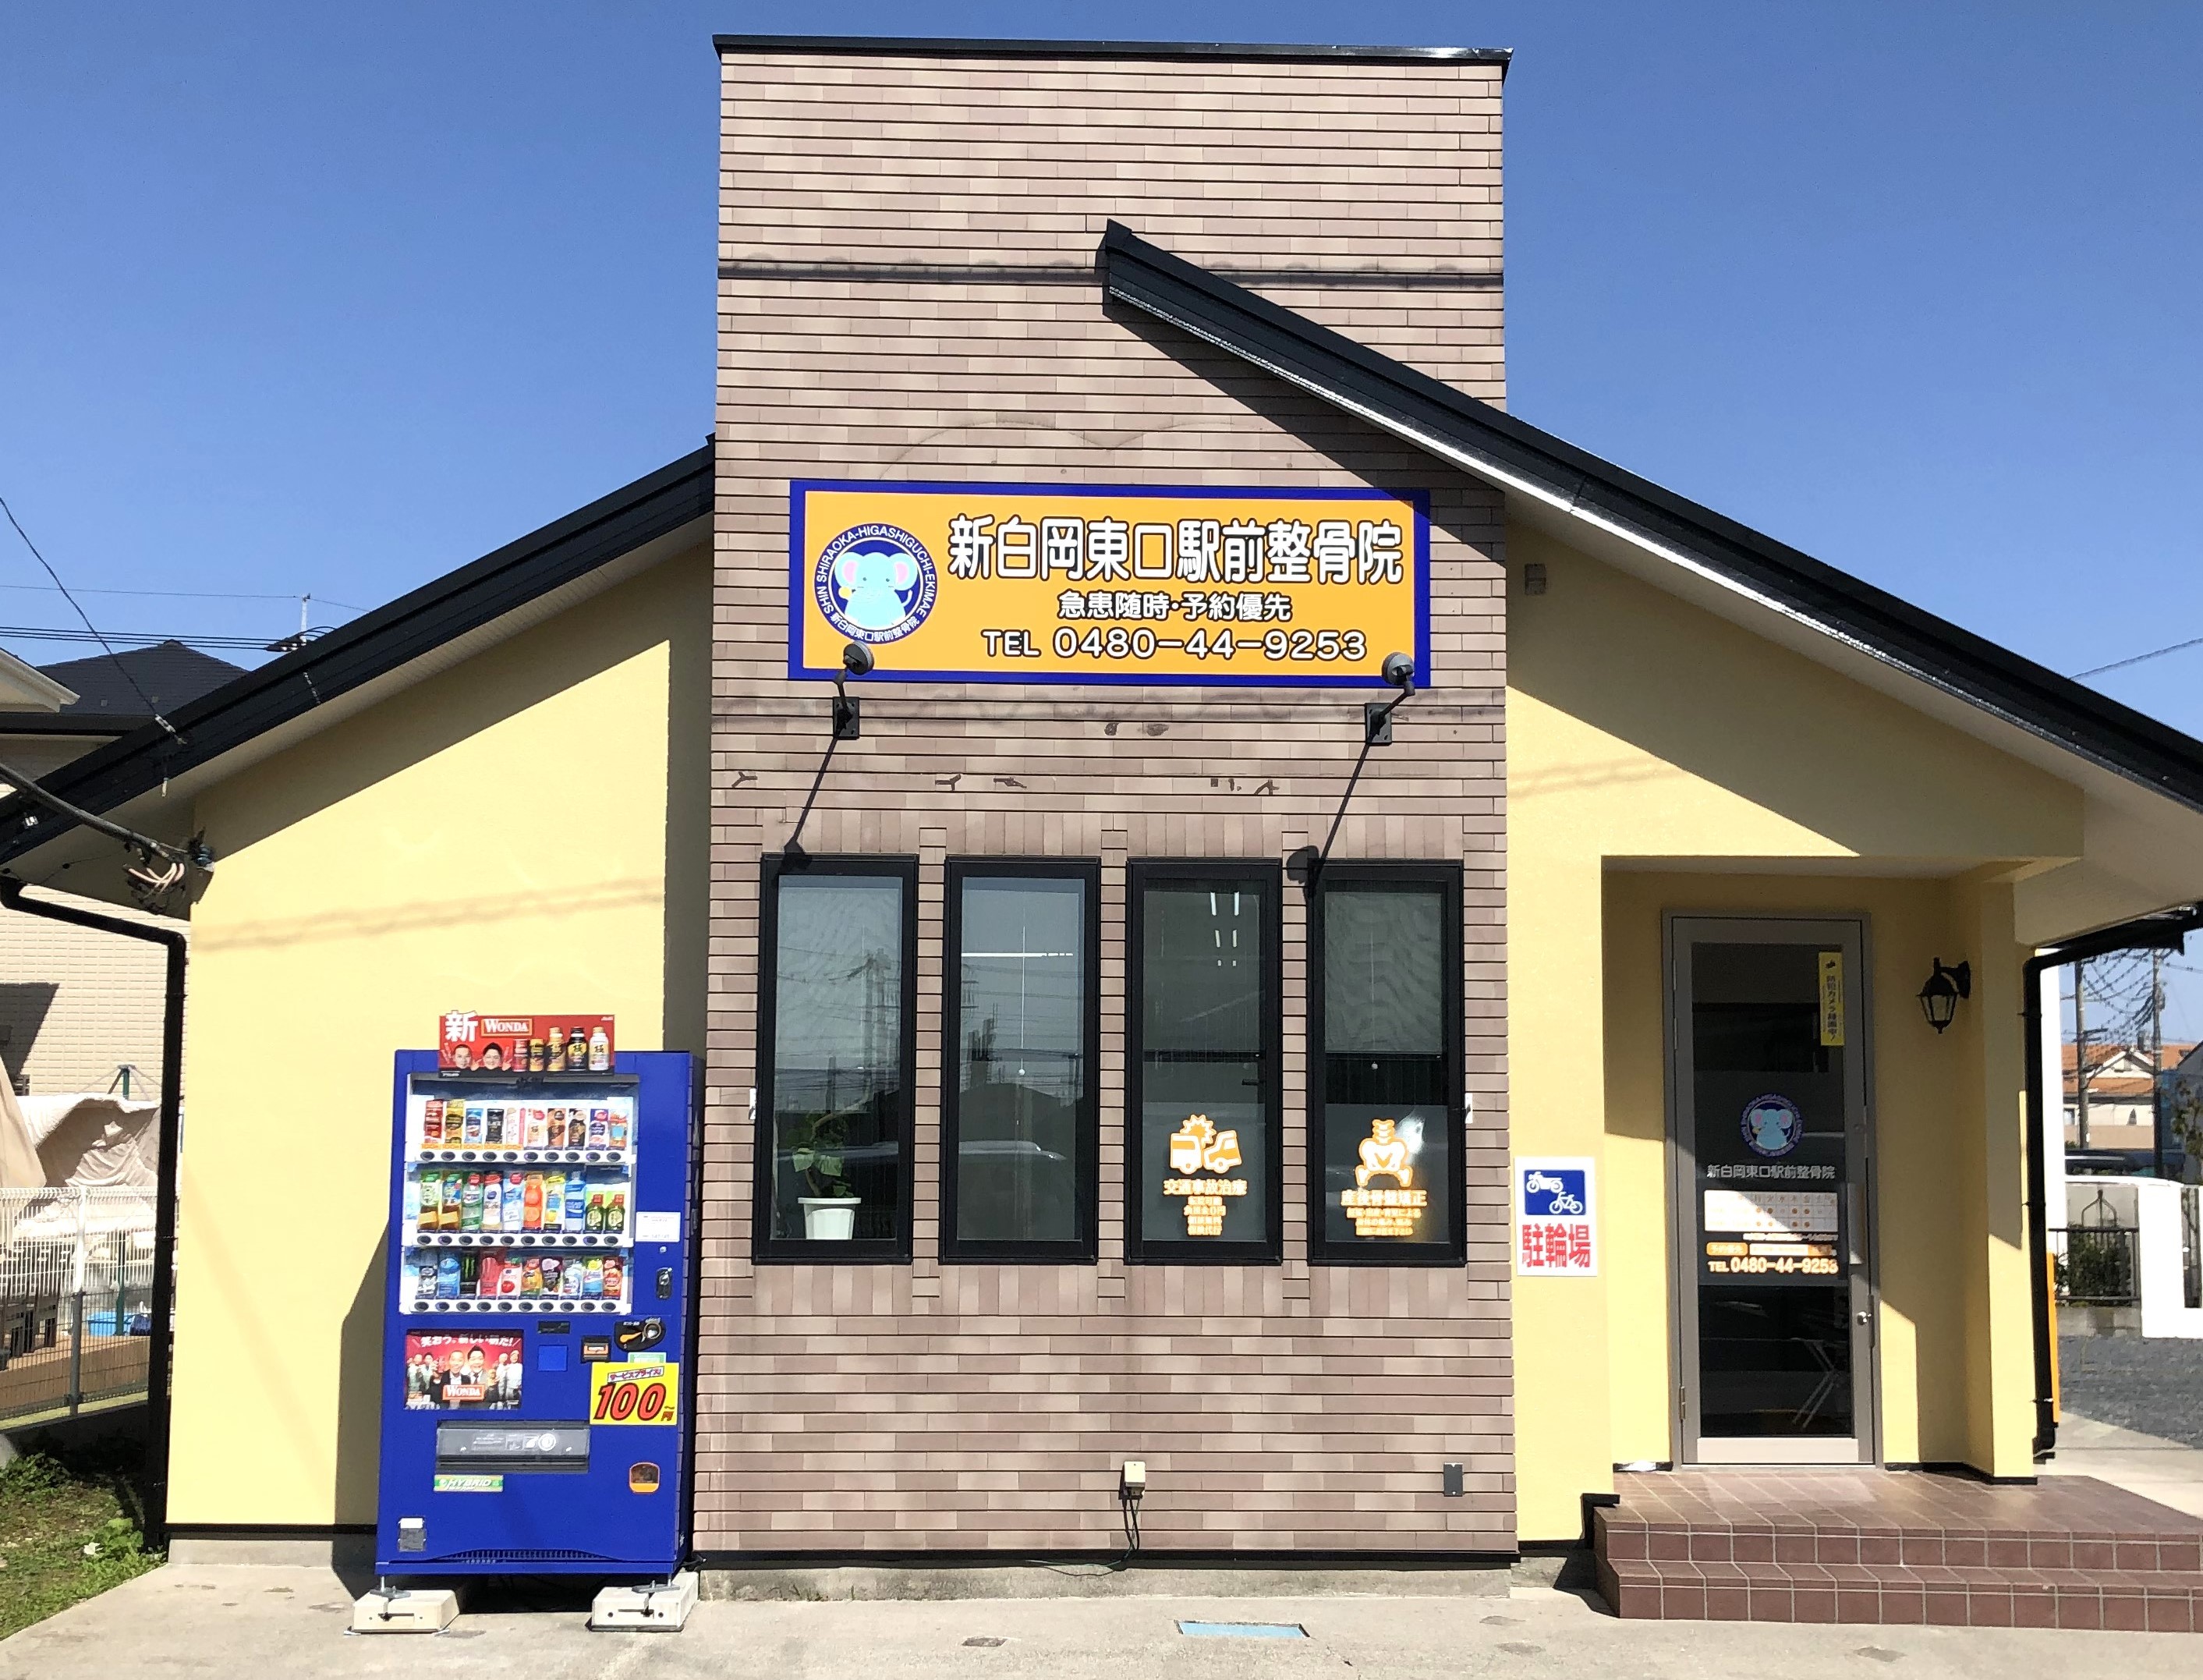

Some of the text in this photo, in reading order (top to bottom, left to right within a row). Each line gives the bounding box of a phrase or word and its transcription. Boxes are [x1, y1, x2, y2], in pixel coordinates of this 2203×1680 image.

[948, 513, 1404, 584] 新白岡東口駅前整骨院
[816, 586, 834, 614] SHIN
[831, 612, 919, 642] 新白岡東口駅前整骨院
[981, 626, 1367, 661] TEL 0480-44-9253
[445, 1010, 479, 1042] 新
[483, 1018, 529, 1034] WONDA
[1706, 1164, 1836, 1179] 新白岡東口駅前整骨院
[1522, 1222, 1592, 1268] 駐輪場
[1708, 1260, 1730, 1273] TEL
[446, 1385, 481, 1398] WONDA
